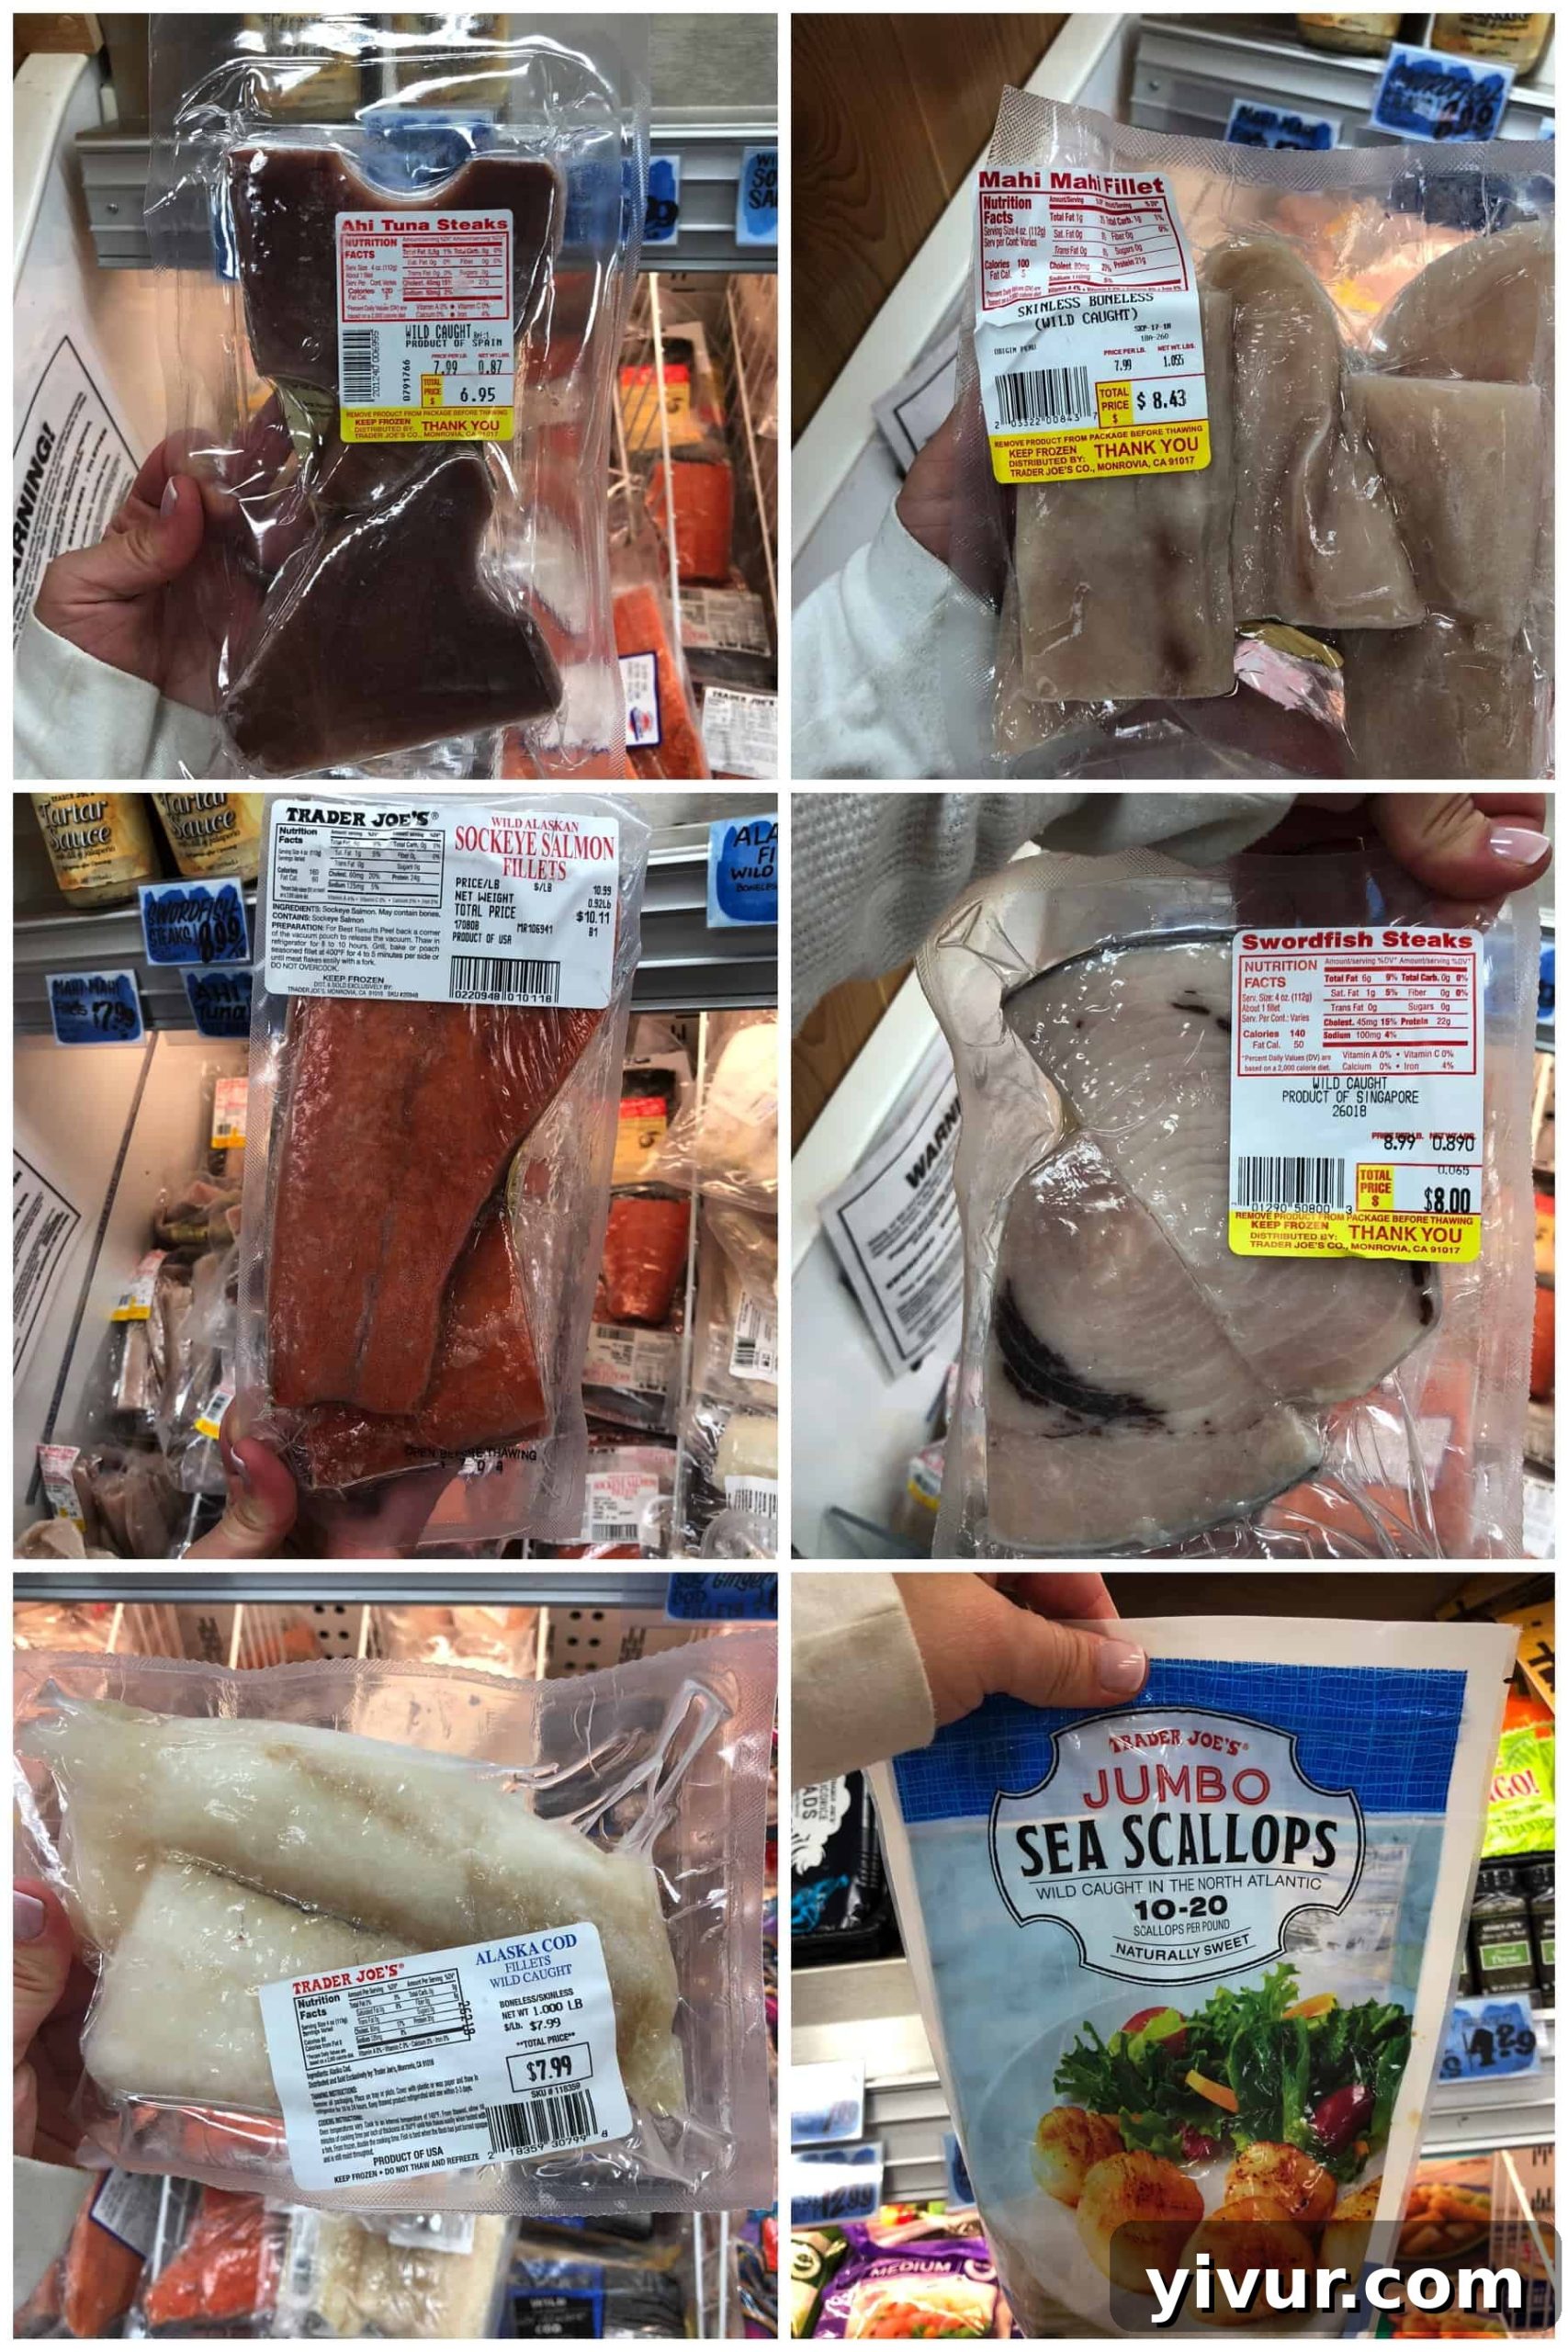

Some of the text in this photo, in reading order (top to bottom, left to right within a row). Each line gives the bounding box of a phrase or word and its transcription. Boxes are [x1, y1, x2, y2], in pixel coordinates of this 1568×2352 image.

[979, 171, 1164, 195] Mahi Mahi Fillet
[984, 196, 1032, 209] Nutrition
[342, 219, 508, 232] Ahi Tuna Steaks
[984, 211, 1013, 224] Facts
[345, 239, 397, 247] NUTRITION
[345, 251, 375, 259] FACTS
[985, 259, 1030, 269] Calories 100
[1018, 292, 1154, 317] SKINLESS BONELESS
[1035, 308, 1138, 332] (WILD CAUGHT)
[406, 324, 471, 339] WILD CAUGHT
[406, 339, 446, 347] PRODUCT
[434, 360, 502, 375] 7.99 0.87
[1114, 359, 1132, 371] 7.99
[402, 359, 411, 401] 0791766
[460, 388, 495, 401] 6.95
[1100, 388, 1129, 397] TOTAL
[1136, 390, 1186, 410] $ 8.43
[1102, 401, 1129, 410] PRICE
[422, 420, 499, 431] THANK YOU
[1094, 436, 1200, 458] THANK YOU
[13, 420, 56, 586] ARNING!
[39, 800, 107, 827] Tartar
[286, 808, 430, 827] TRADER JOE'S
[171, 809, 236, 839] Sauce
[279, 827, 317, 835] Nutrition
[491, 817, 579, 832] WILD ALASKAN
[49, 826, 111, 852] Sauce
[278, 836, 303, 844] Facts
[455, 826, 615, 861] SOCKEYE SALMON
[503, 858, 566, 881] FILLETS
[456, 877, 500, 888] PRICE/LB
[593, 886, 612, 896] 10.99
[455, 891, 514, 903] NET WEIGHT
[455, 904, 610, 924] TOTAL PRICE $10.11
[453, 932, 512, 944] PRODUCT OF USA
[1242, 931, 1472, 950] Swordfish Steaks
[1245, 960, 1317, 972] NUTRITION
[1245, 978, 1286, 988] FACTS
[1325, 974, 1342, 982] Total
[1344, 974, 1359, 982] Fat
[1361, 974, 1371, 983] 6g
[1402, 974, 1418, 982] Total
[1420, 974, 1439, 982] Carb.
[1244, 1029, 1305, 1038] Calories 140
[1313, 1077, 1387, 1090] WILD CAUGHT
[1282, 1090, 1419, 1103] PRODUCT OF SINGAPORE
[1332, 1105, 1366, 1117] 26018
[1360, 1170, 1392, 1181] TOTAL
[1360, 1182, 1391, 1193] PRICE
[1424, 1186, 1471, 1214] $8.00
[1348, 1225, 1462, 1244] THANK YOU
[1108, 1729, 1241, 1757] TRADER JOE'S
[1084, 1764, 1271, 1809] JUMBO
[1490, 1770, 1540, 1803] GO!
[1015, 1813, 1338, 1878] SEA SCALLOPS
[1036, 1874, 1322, 1901] WILD CAUGHT IN THE NORTH ATLANTIC
[1134, 1894, 1228, 1921] 10-20
[1134, 1918, 1231, 1937] SCALLOPS PER POUND
[476, 1934, 578, 1966] ALASKA COD
[1116, 1933, 1251, 1962] NATURALLY SWEET
[505, 1955, 551, 1973] FILLETS
[292, 1964, 398, 1995] TRADER JOE'S
[490, 1964, 572, 1989] WILD CAUGHT
[298, 1994, 340, 2008] Nutrition
[499, 1988, 574, 2008] BONELESS/SKINLESS
[299, 2008, 327, 2020] Facts
[502, 2010, 516, 2020] NET
[534, 2002, 563, 2017] 1.000
[568, 1998, 583, 2010] LB
[529, 2018, 561, 2031] $7.99
[526, 2055, 571, 2082] $7.99
[373, 2146, 444, 2166] PRODUCT OF USA
[412, 2163, 430, 2172] THAW
[432, 2160, 446, 2169] AND
[447, 2153, 479, 2165] REFREEZE
[334, 2171, 378, 2183] KEEP FROZEN
[869, 2261, 952, 2278] MEDIUM
